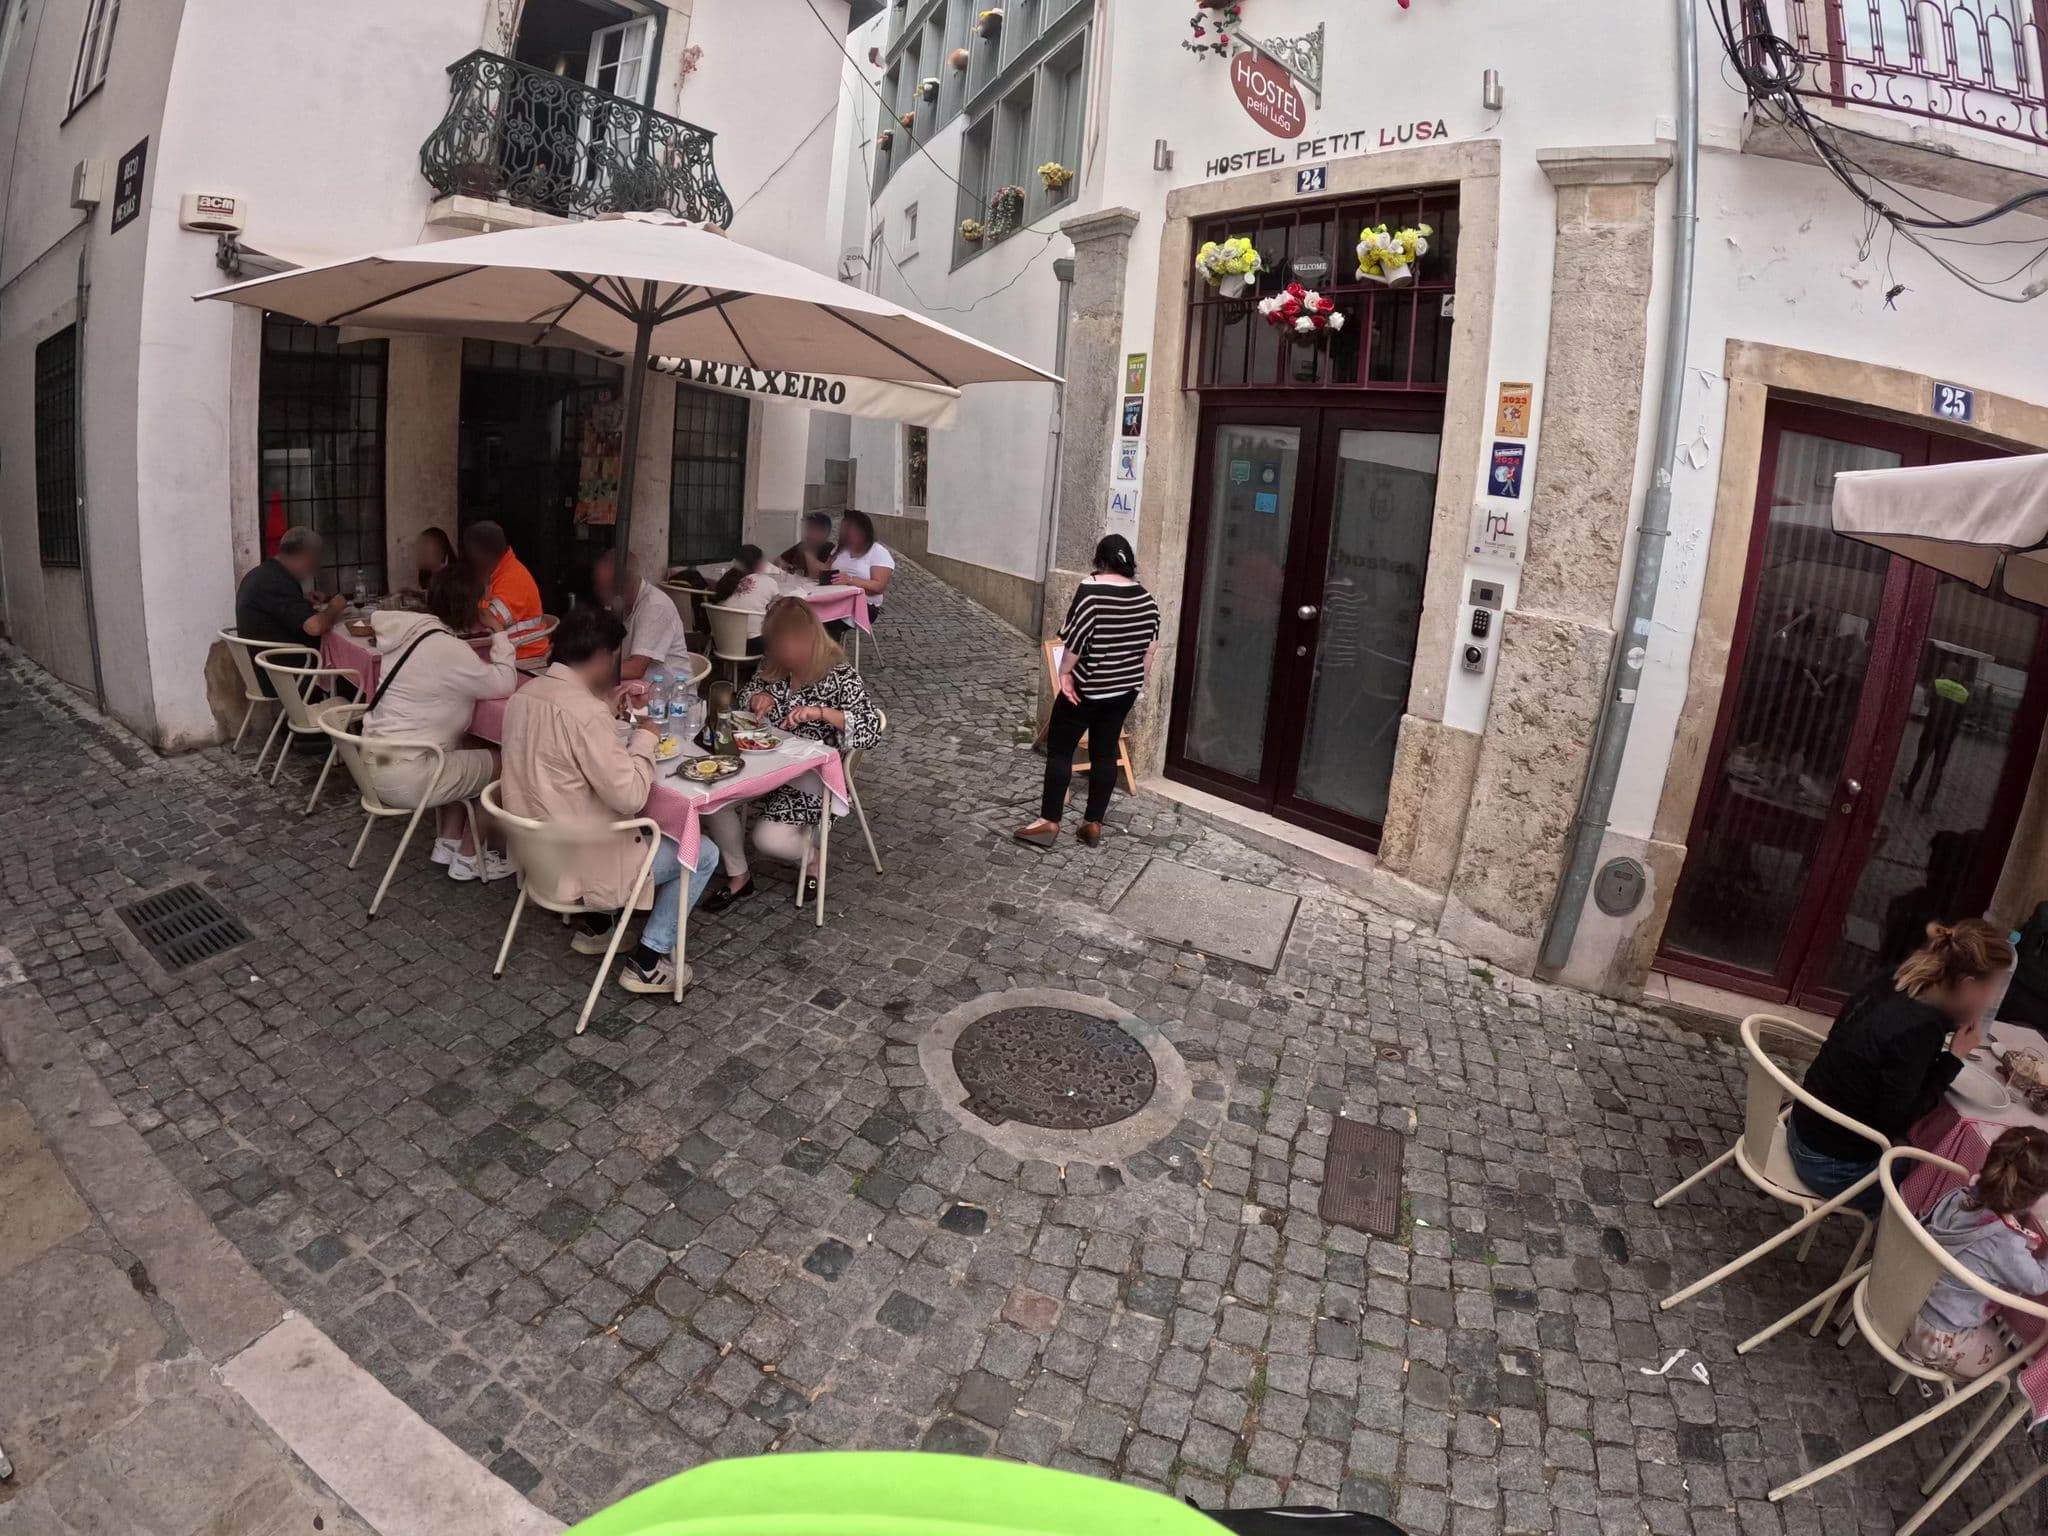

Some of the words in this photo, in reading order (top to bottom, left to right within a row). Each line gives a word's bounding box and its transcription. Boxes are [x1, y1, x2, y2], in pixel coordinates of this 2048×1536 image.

[1236, 59, 1301, 122] HOSTEL
[1246, 93, 1270, 118] petit
[1206, 146, 1286, 178] HOSTEL
[1295, 129, 1366, 161] PETIT
[1378, 119, 1449, 148] LUSA
[1300, 168, 1322, 192] 24
[200, 196, 233, 209] acm
[1293, 262, 1328, 271] WELCOME
[1502, 396, 1528, 405] 2023
[1941, 387, 1966, 418] 25
[1495, 456, 1520, 465] 2024
[1111, 493, 1132, 511] AL
